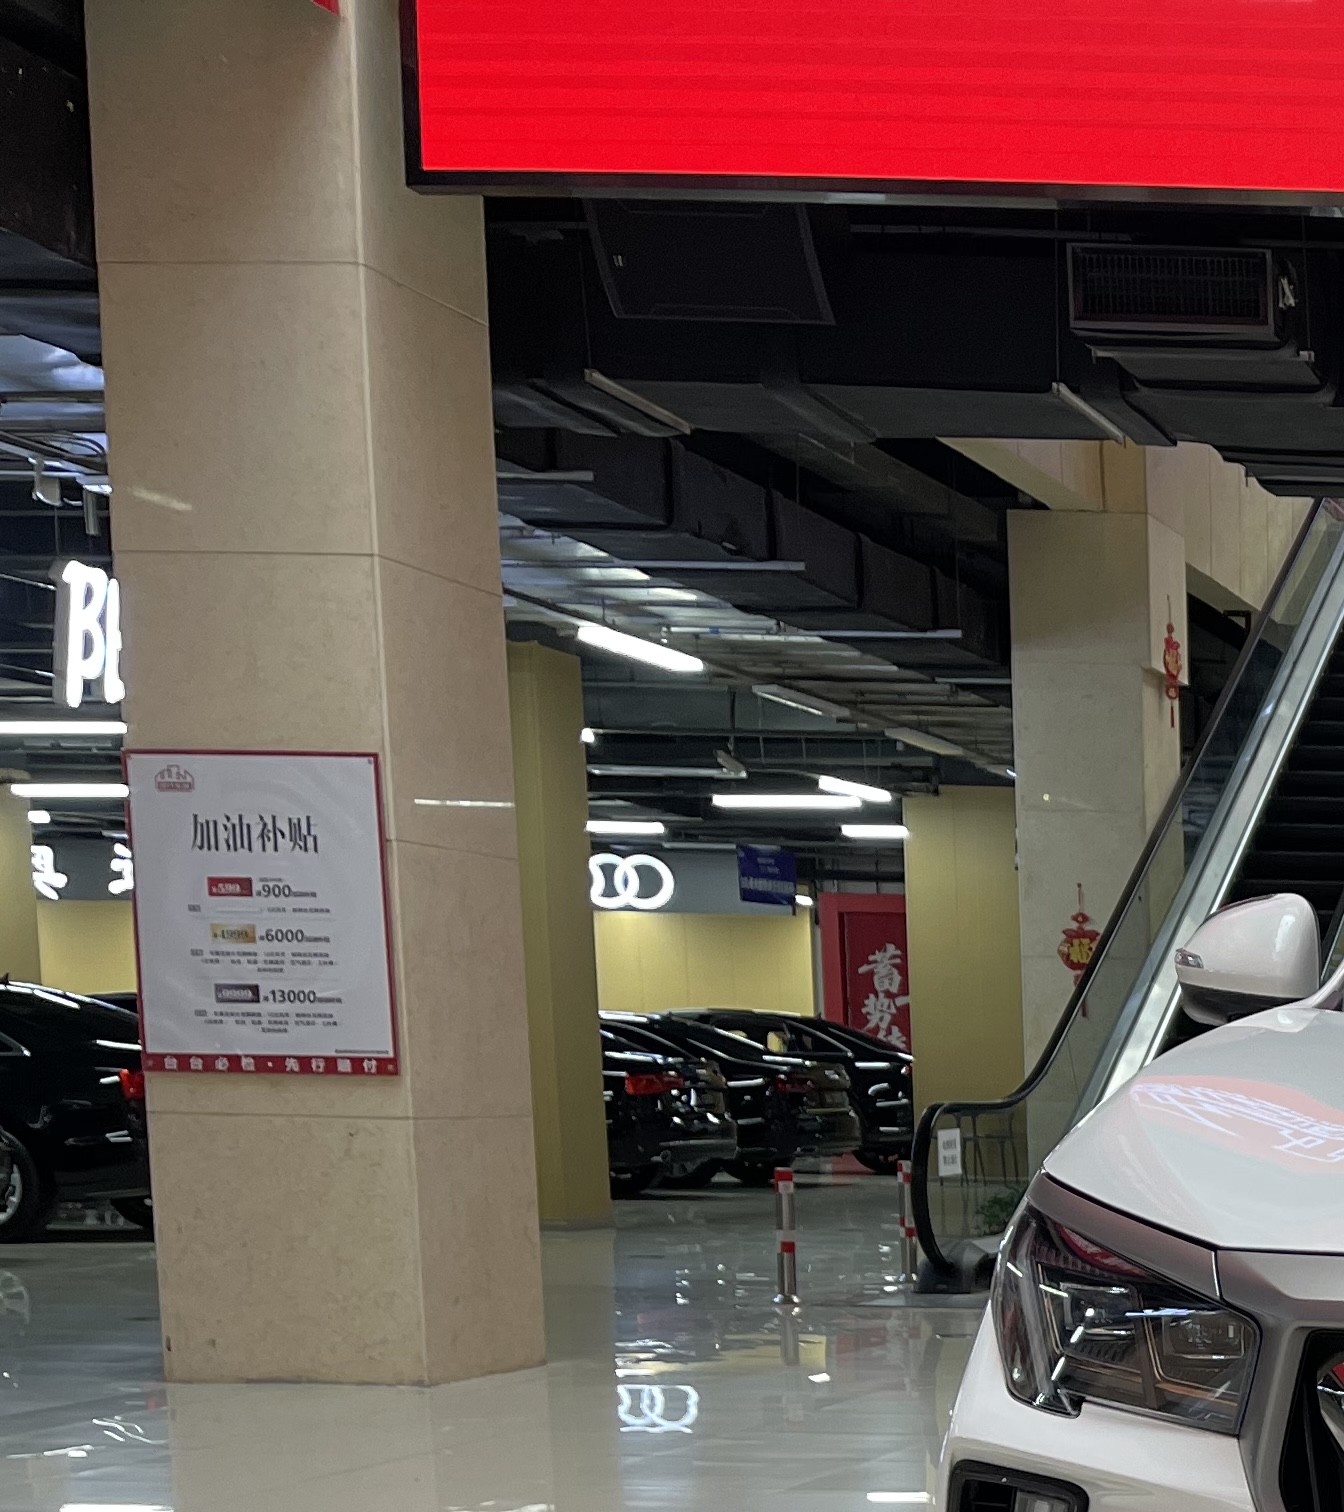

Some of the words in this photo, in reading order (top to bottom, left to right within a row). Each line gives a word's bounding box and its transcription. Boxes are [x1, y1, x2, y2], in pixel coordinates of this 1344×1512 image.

[190, 813, 320, 854] 加油补贴
[265, 929, 304, 943] 6000
[269, 989, 316, 1004] 13000
